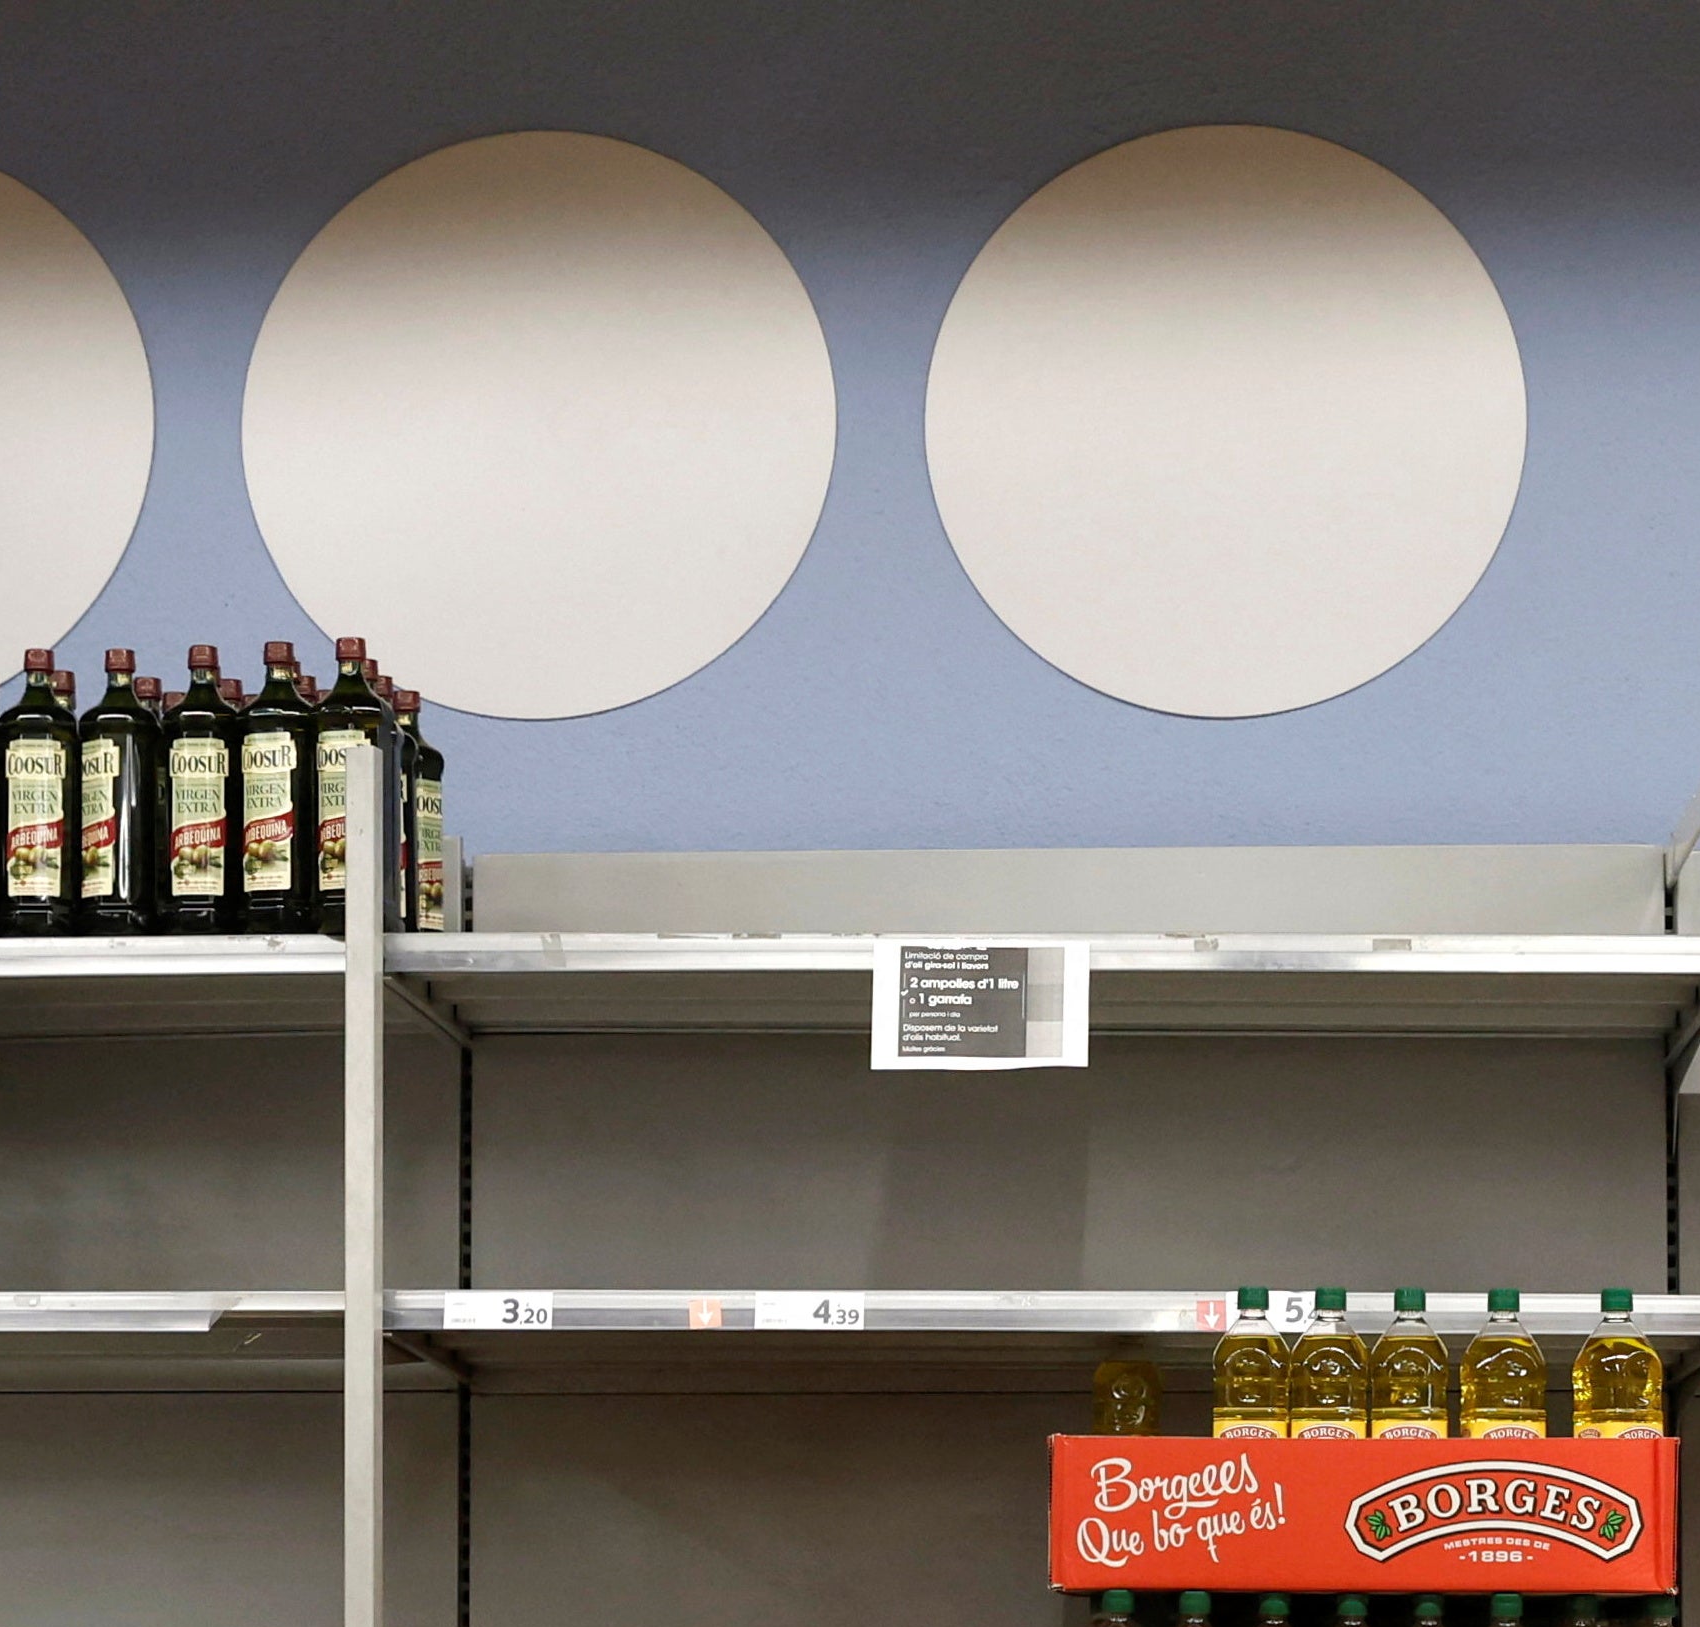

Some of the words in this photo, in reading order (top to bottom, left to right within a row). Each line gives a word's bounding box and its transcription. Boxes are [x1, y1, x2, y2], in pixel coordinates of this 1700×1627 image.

[171, 750, 227, 774] COOSUR
[1388, 1478, 1601, 1532] BORGES
[1077, 1517, 1144, 1567] Que
[1152, 1510, 1192, 1551] bo
[1197, 1510, 1245, 1562] que
[1250, 1483, 1285, 1530] és!
[1444, 1539, 1503, 1550] MESTRES
[1505, 1537, 1532, 1546] DES
[1534, 1540, 1551, 1551] DE
